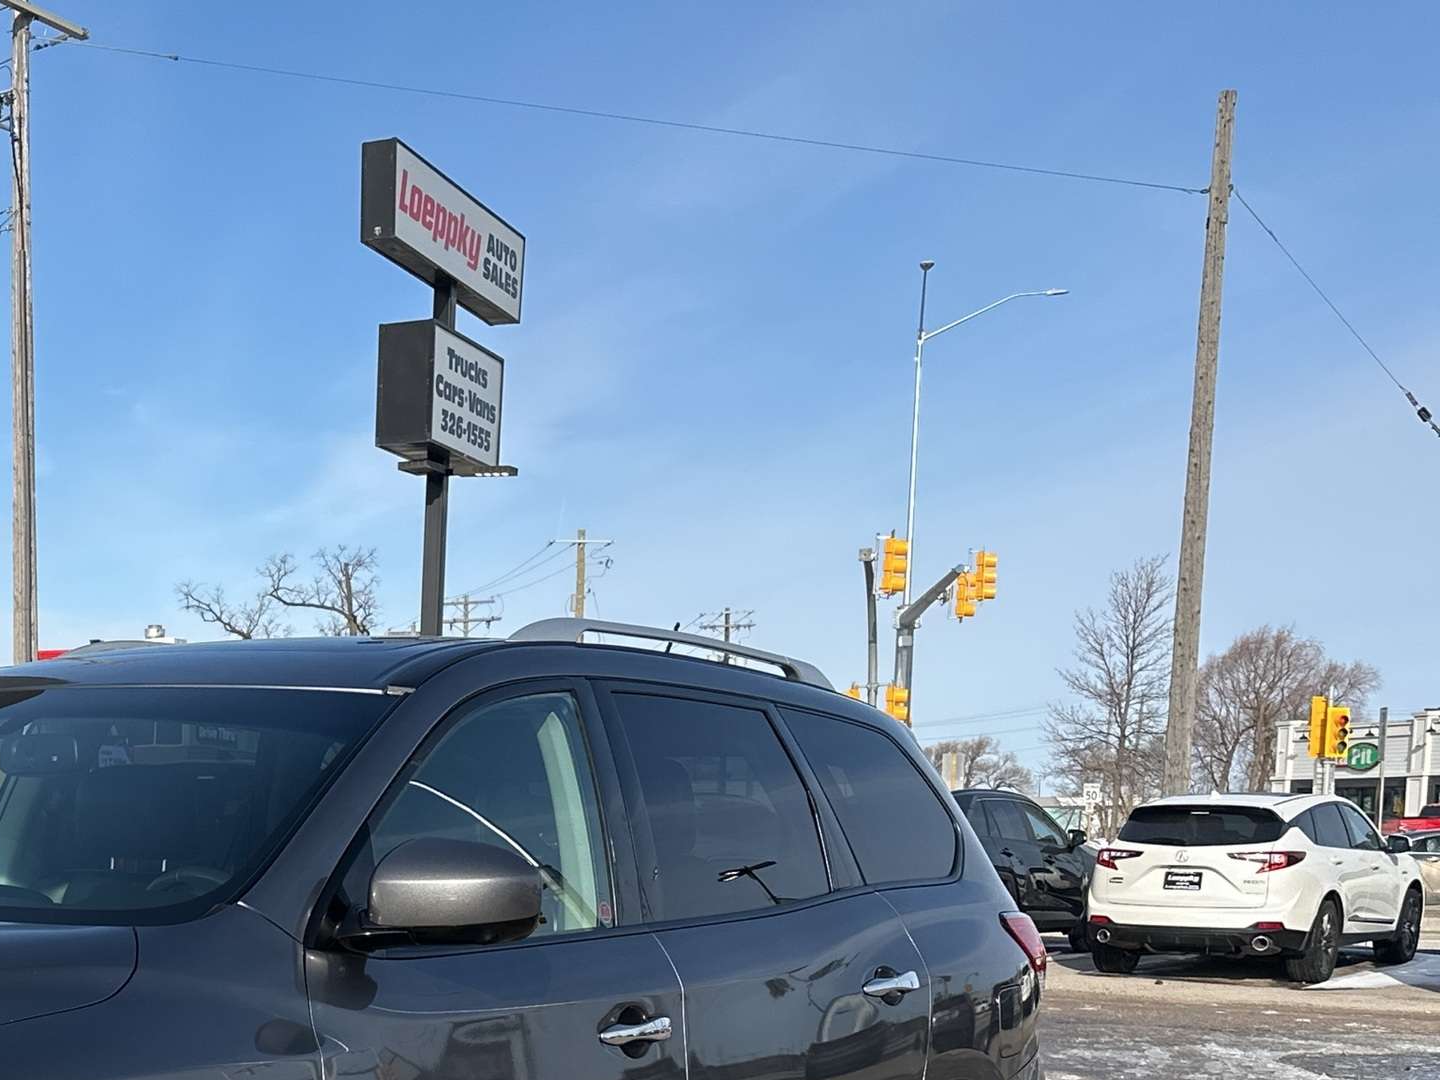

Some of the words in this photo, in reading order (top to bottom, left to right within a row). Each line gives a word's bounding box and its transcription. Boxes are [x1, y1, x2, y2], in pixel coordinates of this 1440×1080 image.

[398, 168, 482, 271] Loeppky
[486, 233, 517, 273] AUTO
[482, 257, 518, 299] SALES
[447, 346, 488, 389] Trucks
[440, 408, 491, 452] 326-1555
[1085, 790, 1098, 801] 50
